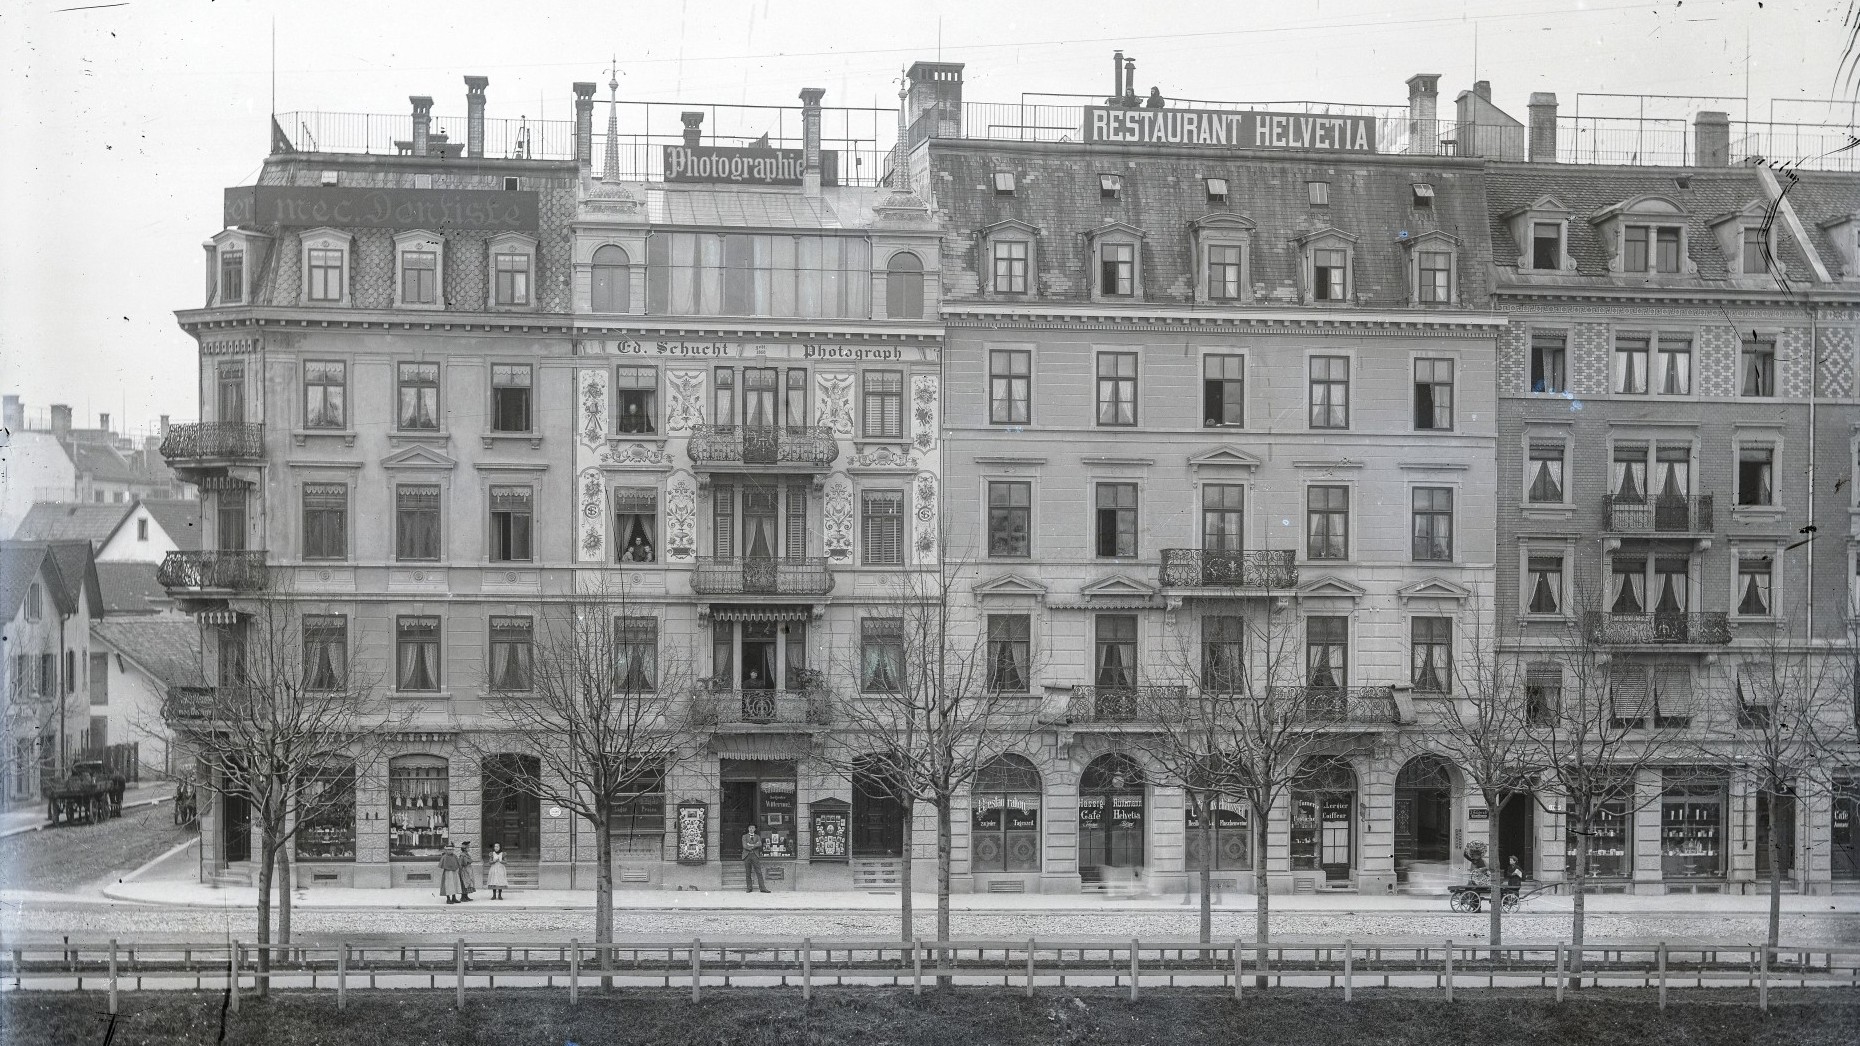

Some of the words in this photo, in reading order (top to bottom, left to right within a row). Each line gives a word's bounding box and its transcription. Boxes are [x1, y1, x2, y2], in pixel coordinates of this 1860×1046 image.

[1092, 109, 1242, 145] RESTAURANT
[1255, 115, 1370, 150] HELVETIA
[666, 147, 807, 182] Photographie
[656, 341, 729, 357] Schucht
[802, 344, 902, 361] Photograph
[1113, 810, 1140, 820] Helvetia
